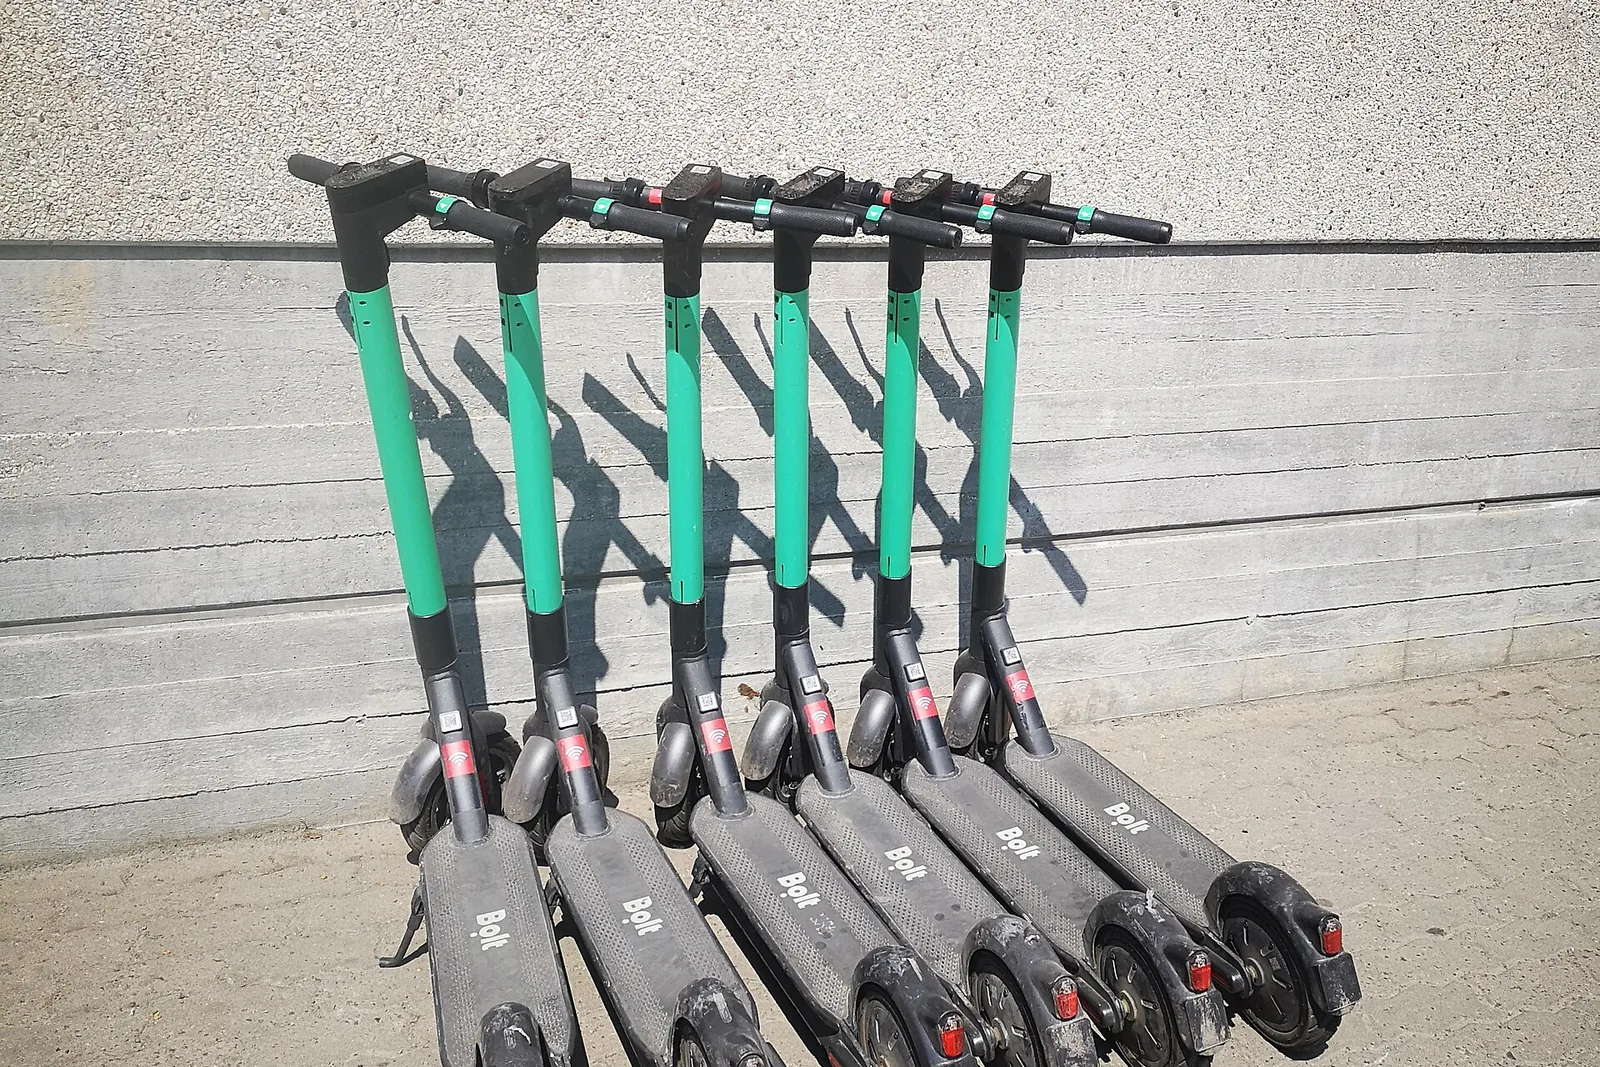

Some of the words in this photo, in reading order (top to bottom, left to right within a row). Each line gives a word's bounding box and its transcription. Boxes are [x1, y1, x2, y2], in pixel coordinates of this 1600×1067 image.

[1104, 802, 1150, 834] Bolt
[996, 826, 1040, 860] Bolt
[884, 845, 928, 881] Bolt
[777, 872, 821, 909] Bolt
[470, 909, 511, 951] Bolt
[622, 896, 663, 936] Bolt
